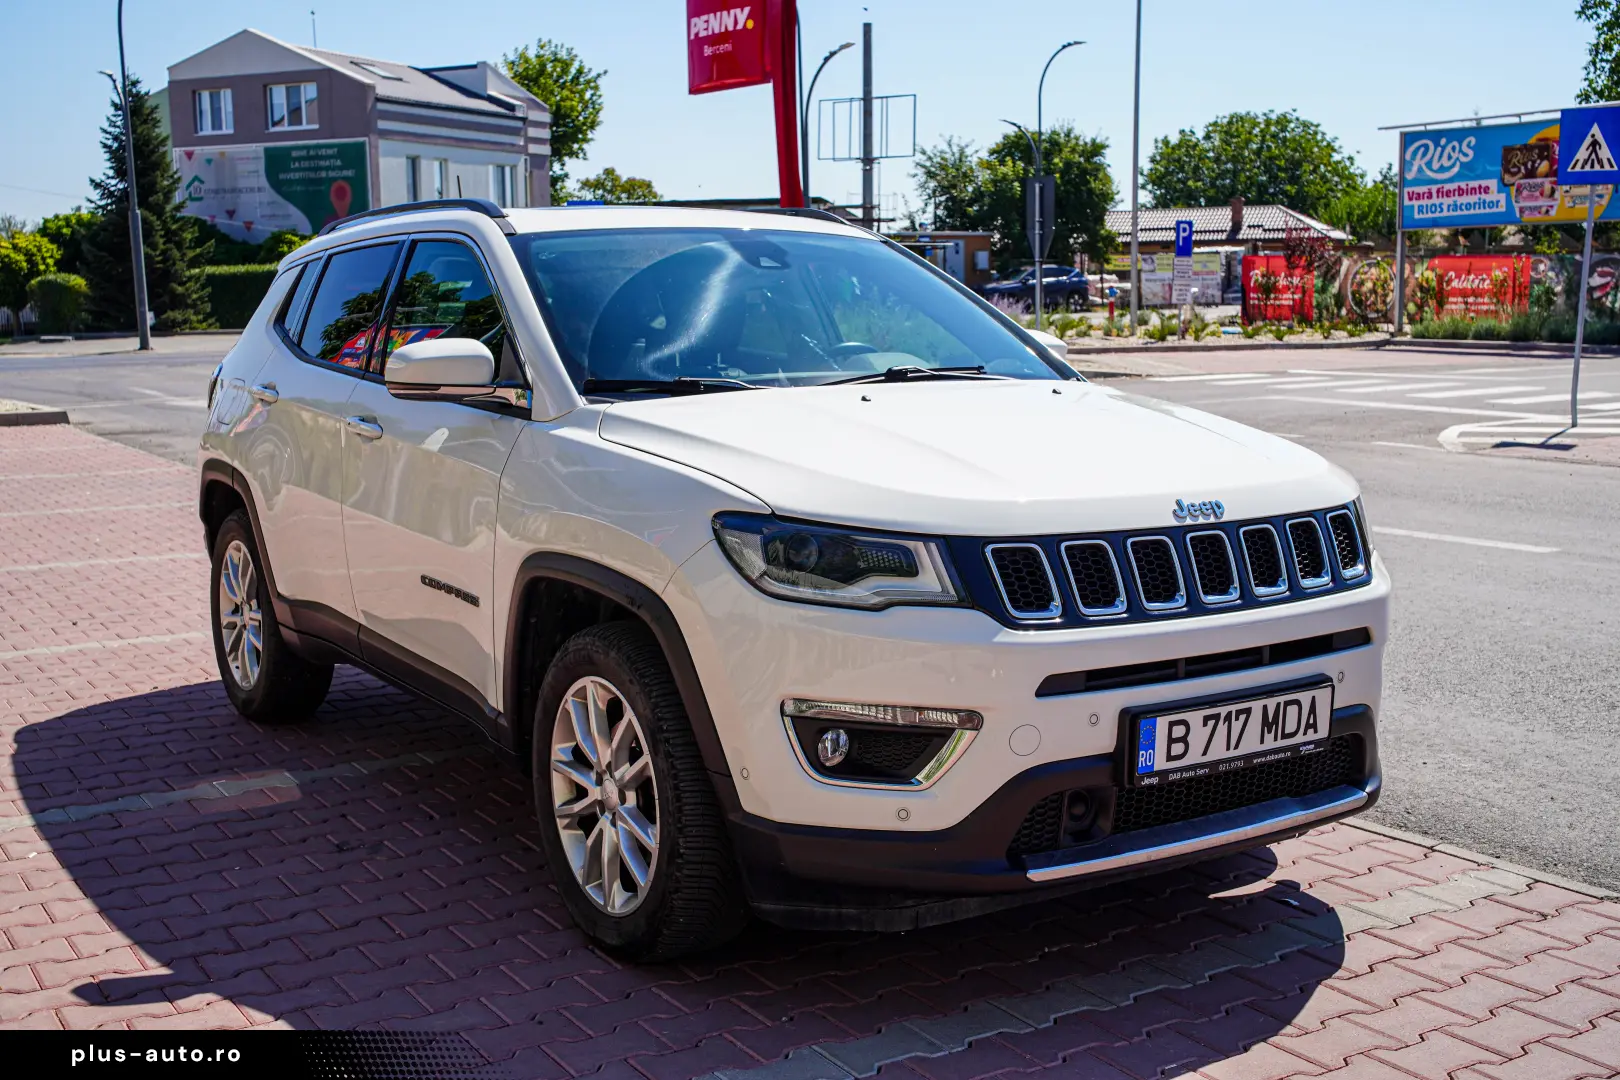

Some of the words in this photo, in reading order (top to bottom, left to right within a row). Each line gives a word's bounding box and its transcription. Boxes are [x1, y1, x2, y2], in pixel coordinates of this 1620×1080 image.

[703, 40, 733, 57] Berceni
[1405, 136, 1476, 180] Rios
[1407, 190, 1433, 201] Vară
[1417, 203, 1444, 217] RIOS
[1179, 223, 1190, 246] P
[1172, 499, 1225, 523] Jeep
[1165, 719, 1190, 762] B
[1201, 707, 1252, 756] 717
[1260, 696, 1318, 744] MDA
[1138, 749, 1154, 768] RO
[1141, 776, 1159, 785] Jeep
[1168, 772, 1181, 781] DAB
[1181, 770, 1195, 779] Auto
[1196, 767, 1210, 776] Serv
